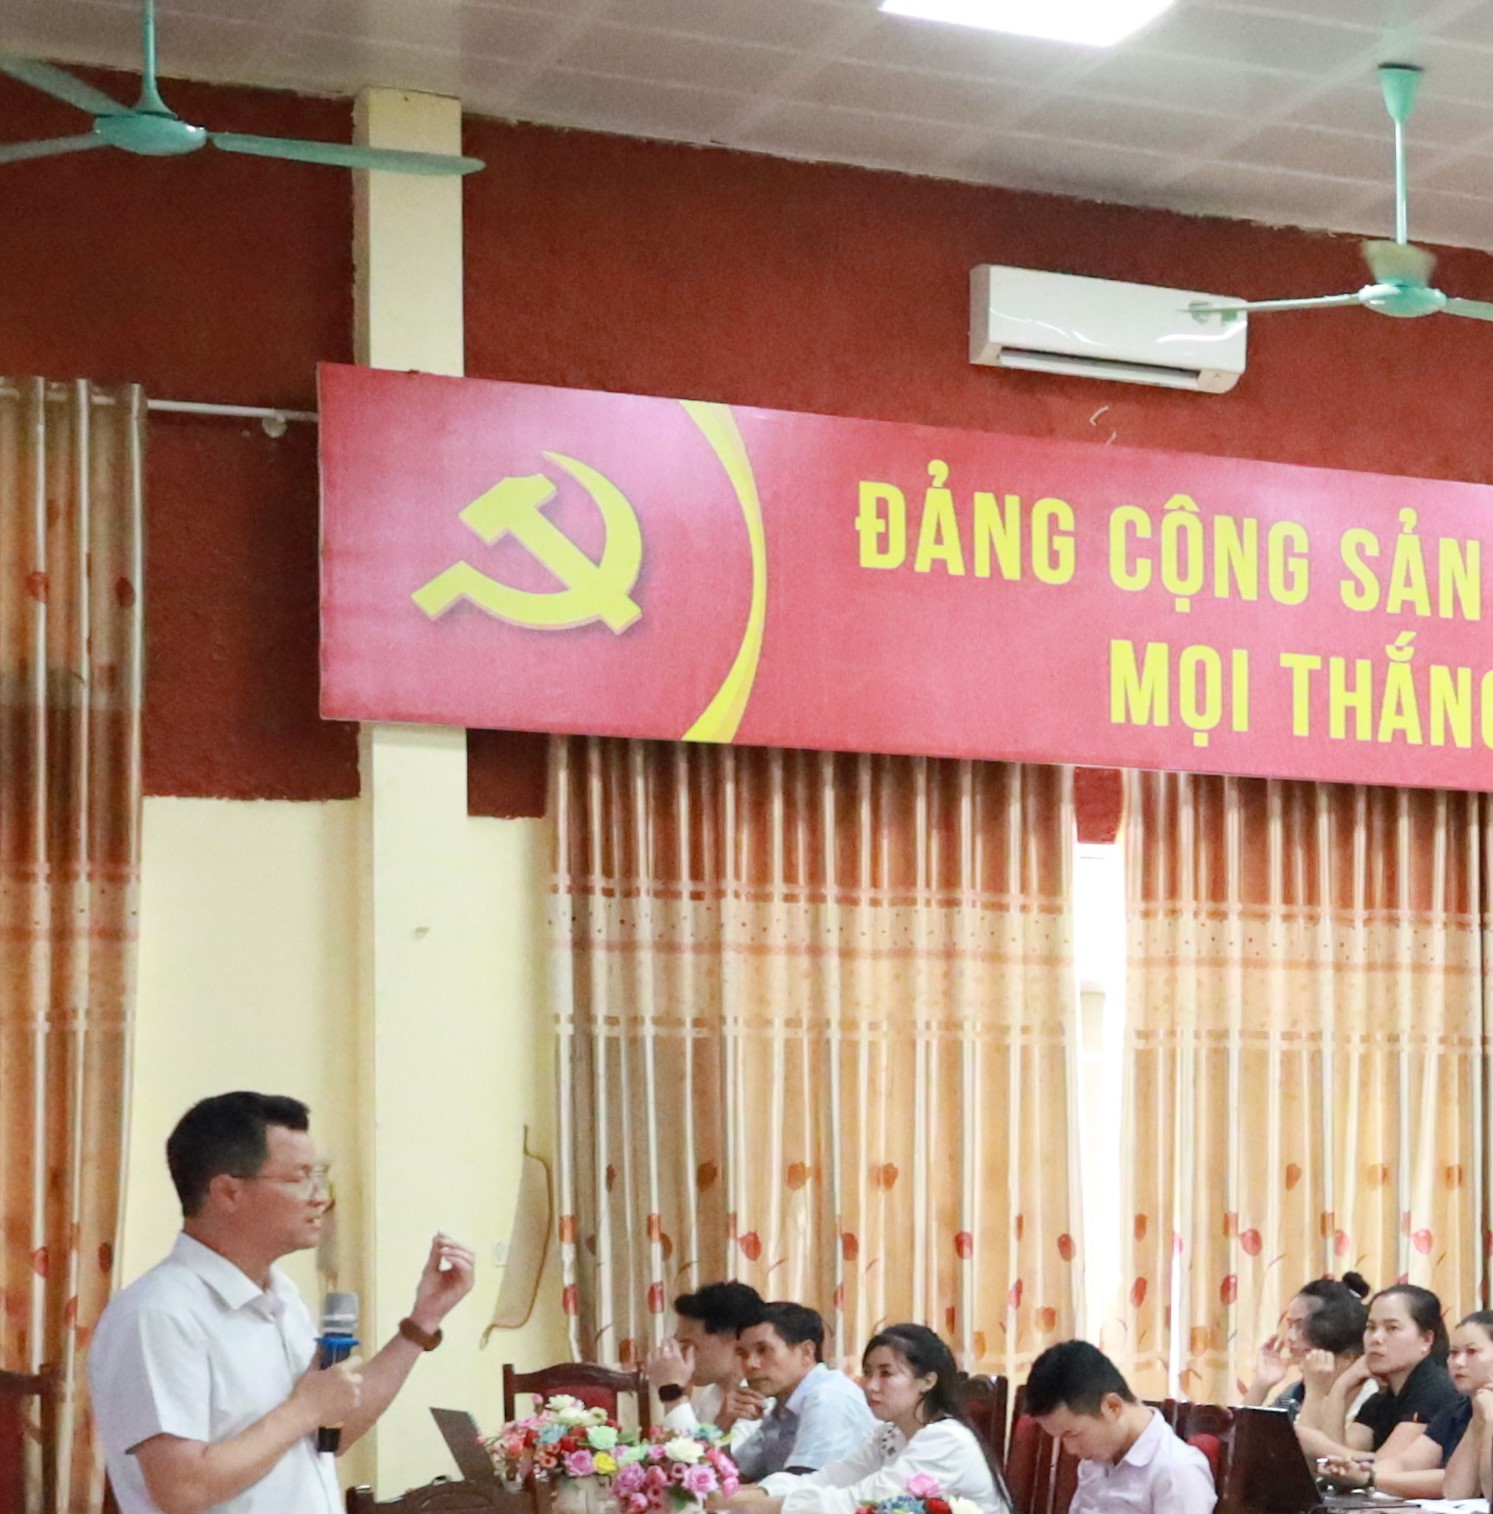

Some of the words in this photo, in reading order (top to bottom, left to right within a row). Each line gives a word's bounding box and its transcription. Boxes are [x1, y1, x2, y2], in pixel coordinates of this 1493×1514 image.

[855, 459, 1076, 584] ĐẢNG
[1109, 494, 1309, 612] CỘNG
[1340, 508, 1481, 621] SẢN
[1110, 639, 1249, 746] MỌI
